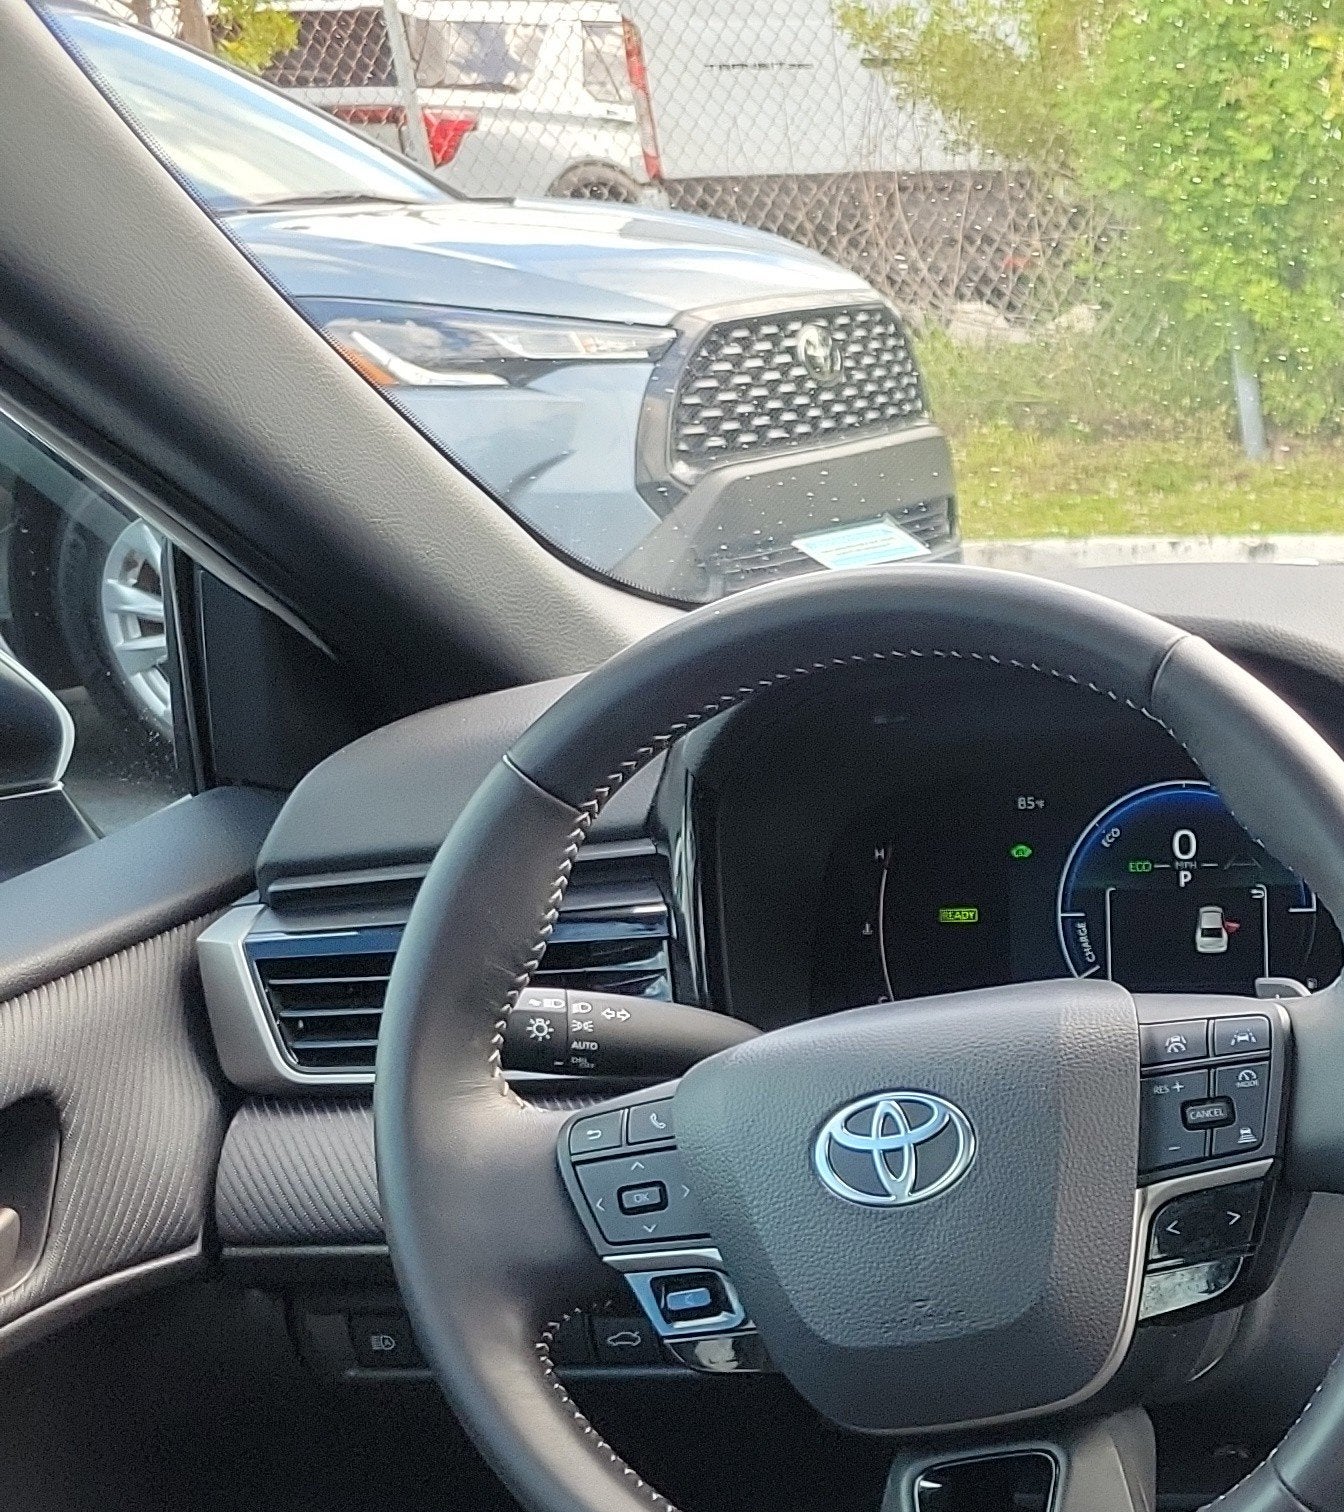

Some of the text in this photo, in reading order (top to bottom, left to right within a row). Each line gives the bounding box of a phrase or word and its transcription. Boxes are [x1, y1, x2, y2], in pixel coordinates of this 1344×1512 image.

[1172, 828, 1197, 860] 0
[1180, 870, 1192, 887] P
[1075, 921, 1096, 963] CHARGE
[571, 1041, 598, 1050] AUTO
[1189, 1108, 1224, 1120] CANCEL
